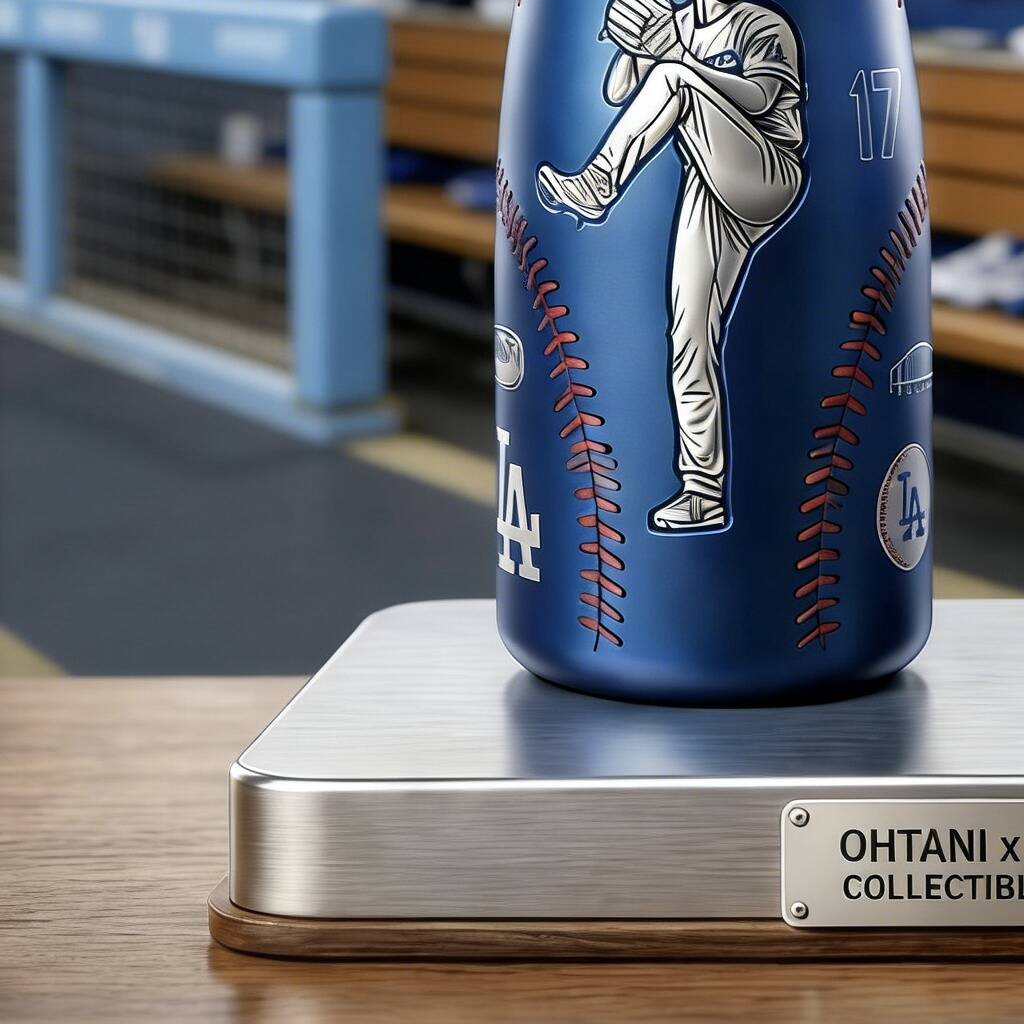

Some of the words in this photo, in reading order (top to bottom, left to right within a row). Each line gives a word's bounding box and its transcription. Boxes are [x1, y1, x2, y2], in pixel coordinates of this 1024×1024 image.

[848, 66, 902, 161] 17
[496, 425, 541, 583] LA
[897, 471, 926, 542] LA
[839, 828, 988, 864] OHTANI
[999, 835, 1021, 863] x
